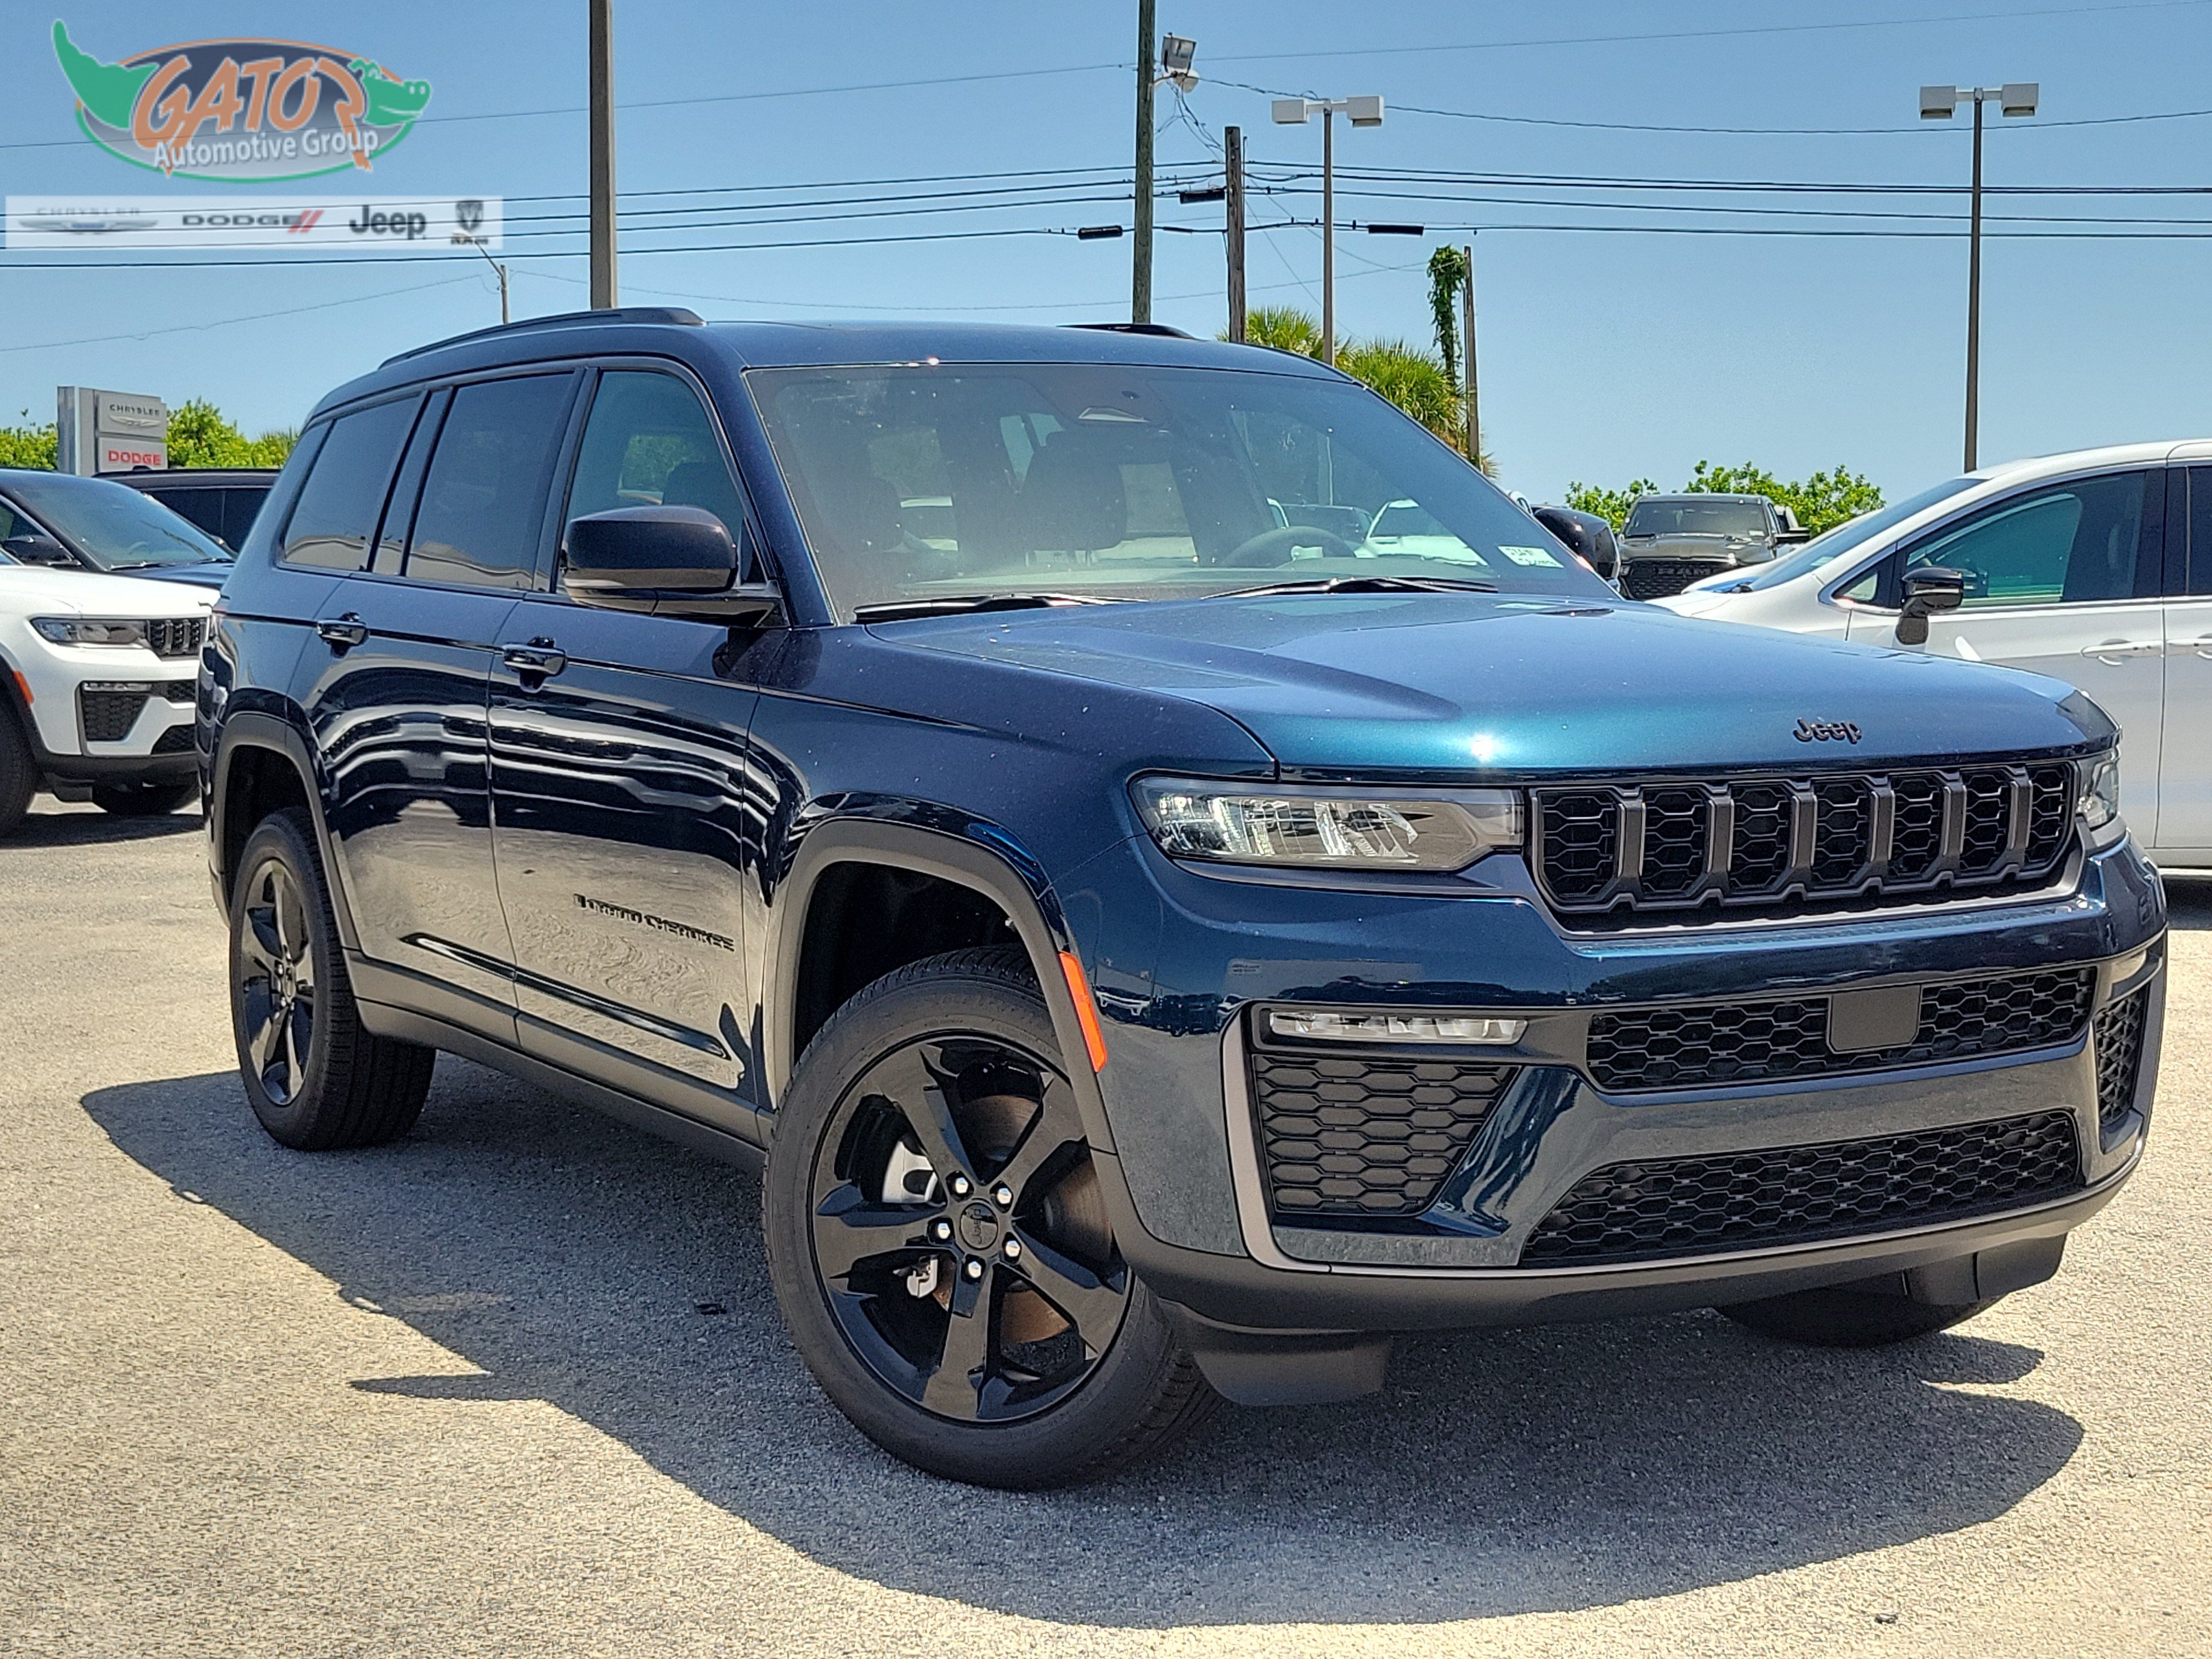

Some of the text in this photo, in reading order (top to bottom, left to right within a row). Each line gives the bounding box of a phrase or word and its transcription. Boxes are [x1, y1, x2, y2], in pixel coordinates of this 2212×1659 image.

[110, 404, 160, 416] CHRYSLER
[108, 450, 161, 465] DODGE
[1793, 717, 1862, 744] Jeep
